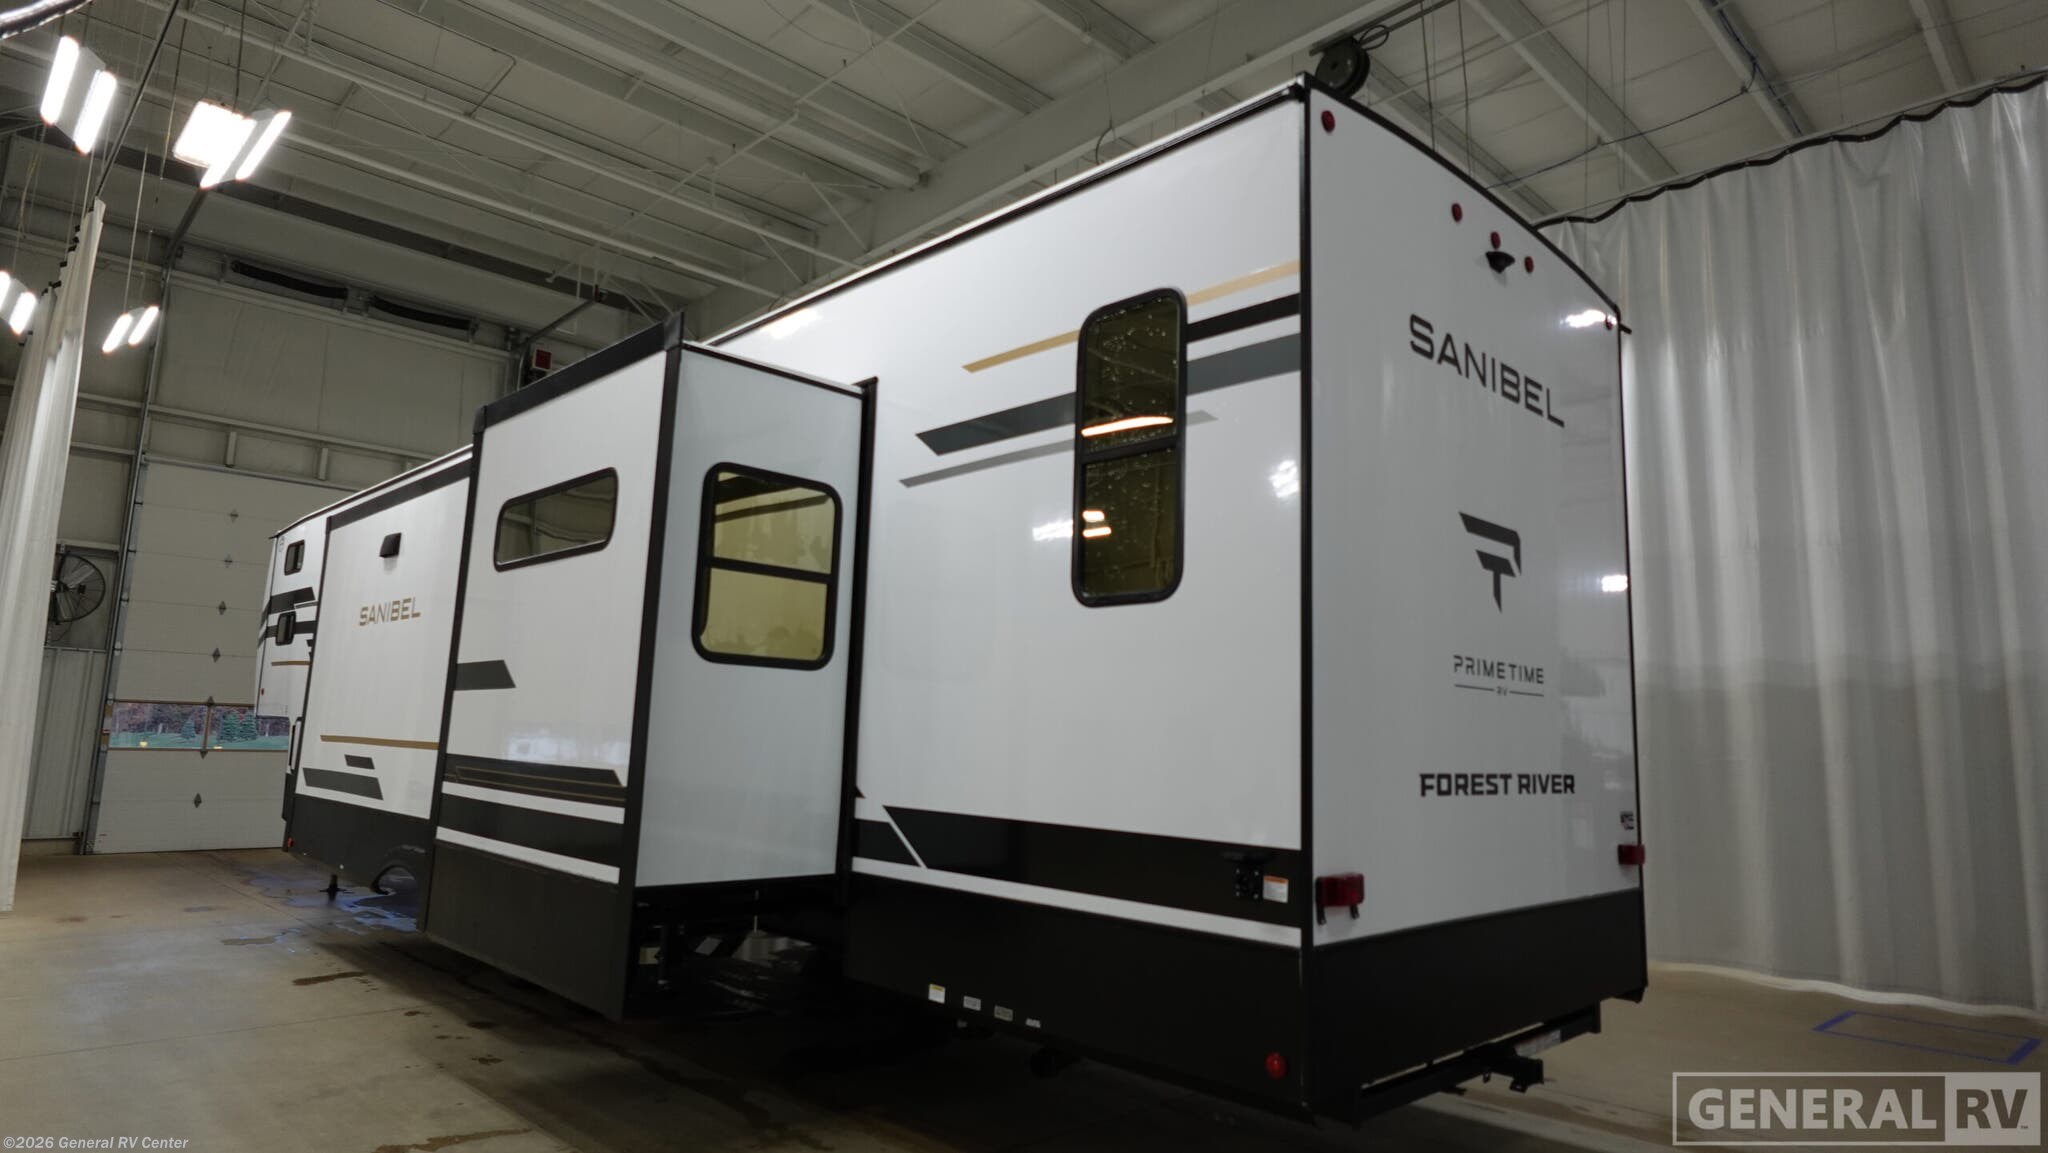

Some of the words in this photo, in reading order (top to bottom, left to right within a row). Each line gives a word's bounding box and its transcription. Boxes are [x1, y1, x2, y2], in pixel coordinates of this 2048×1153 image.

[1409, 313, 1565, 429] SANIBEL
[359, 596, 421, 626] SANIBEL
[1420, 773, 1512, 797] FOREST
[1517, 773, 1575, 795] RIVER
